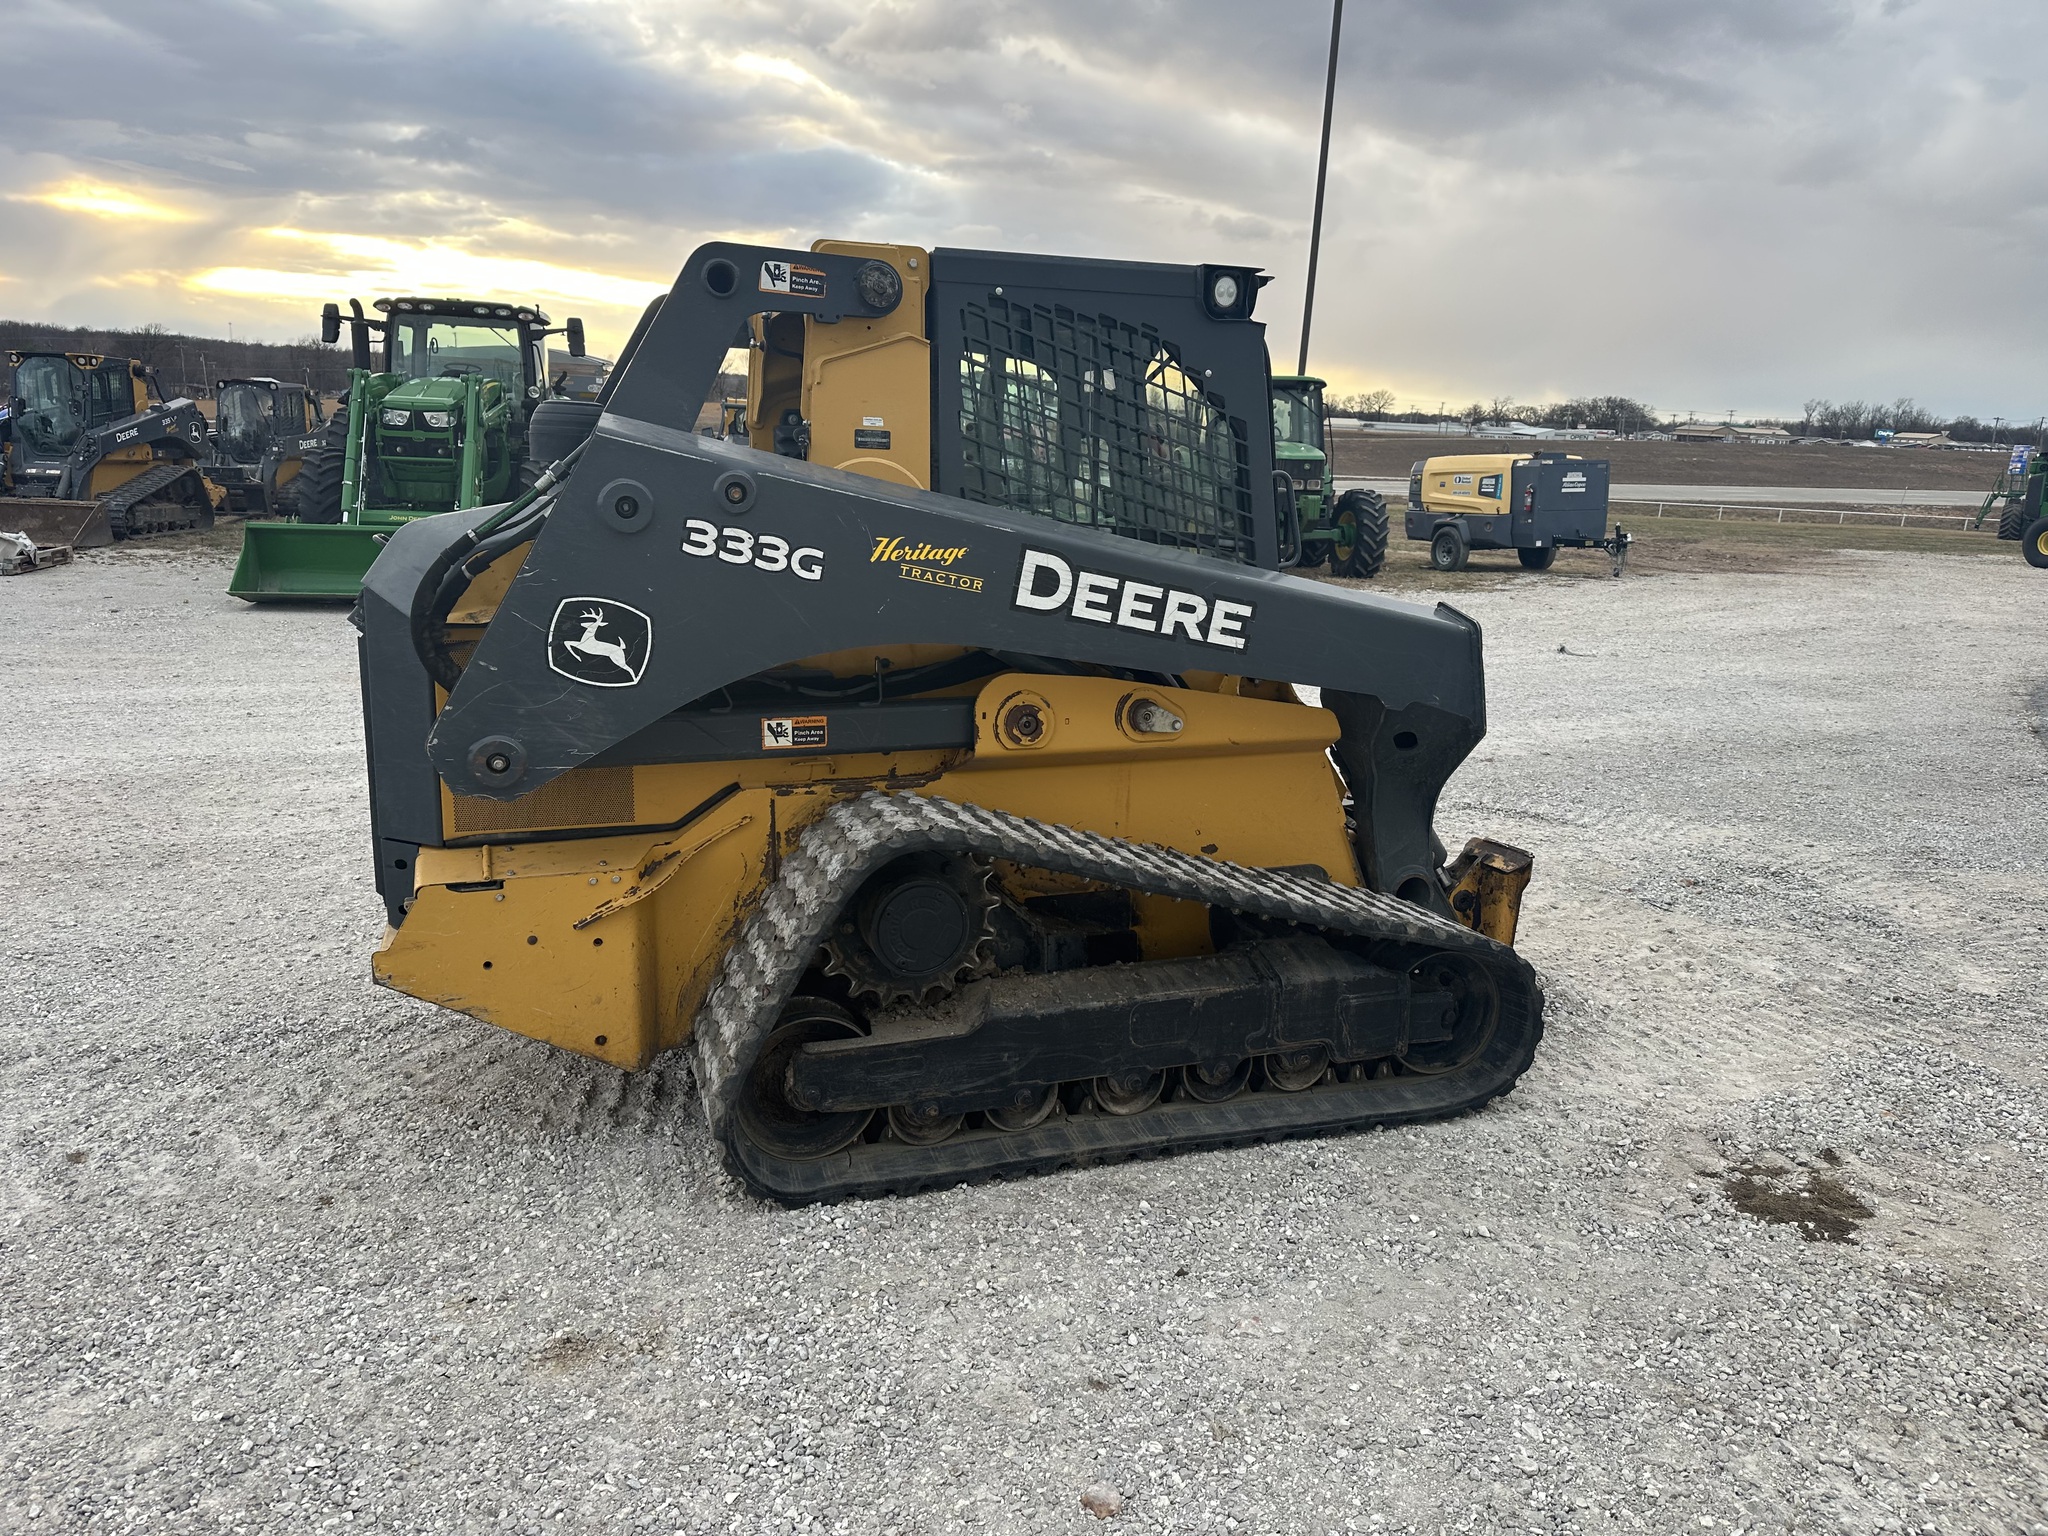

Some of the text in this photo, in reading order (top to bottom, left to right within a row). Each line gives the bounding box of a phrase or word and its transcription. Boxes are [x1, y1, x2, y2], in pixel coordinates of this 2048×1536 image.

[792, 276, 809, 284] Pinch
[805, 285, 819, 293] Away
[116, 427, 139, 443] DEERE
[298, 438, 318, 450] DEERE
[682, 519, 825, 581] 333G
[870, 536, 969, 566] Heritage
[900, 565, 984, 591] TRACTOR
[1016, 549, 1253, 650] DEERE
